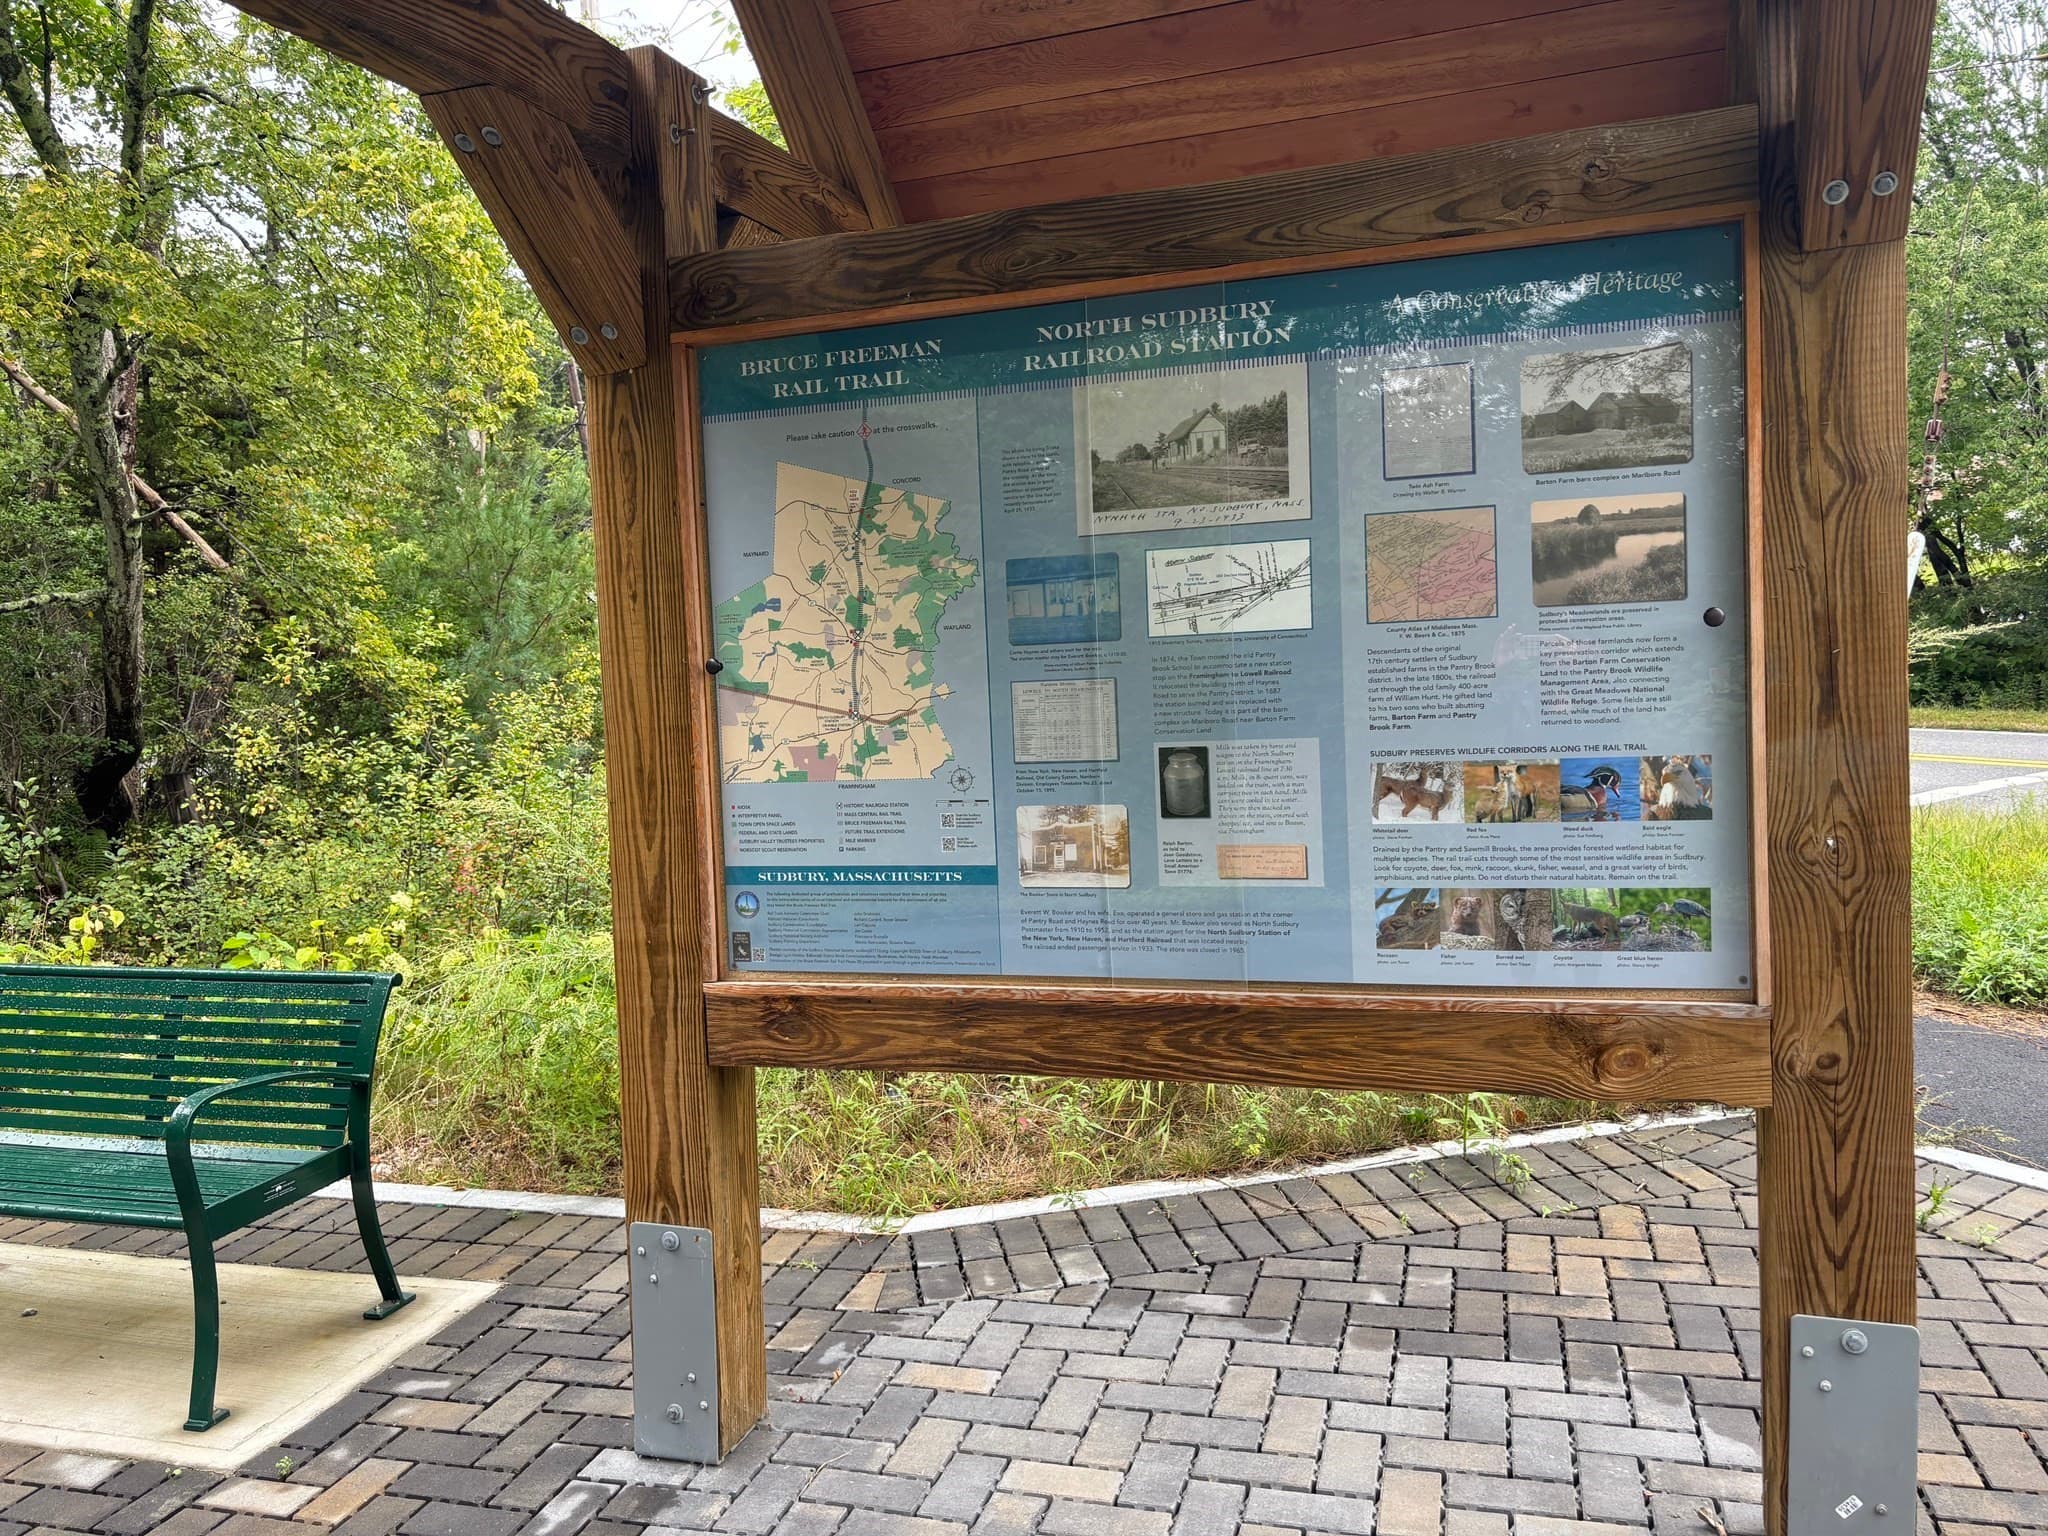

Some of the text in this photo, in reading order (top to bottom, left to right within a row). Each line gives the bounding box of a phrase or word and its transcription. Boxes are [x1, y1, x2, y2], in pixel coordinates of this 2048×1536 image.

[1387, 269, 1684, 318] A Conservation Heritage
[1037, 300, 1276, 342] NORTH SUDBURY
[1024, 327, 1291, 371] RAILROAD STATION
[740, 339, 941, 376] BRUCE FREEMAN
[773, 370, 909, 398] RAIL TRAIL
[785, 432, 808, 442] Please
[828, 427, 855, 438] caution
[872, 425, 880, 434] at
[881, 424, 894, 433] the
[896, 419, 938, 432] crosswalks.
[892, 476, 921, 484] CONCORD
[1535, 477, 1557, 485] Barton
[1557, 476, 1574, 484] Farm
[1592, 472, 1620, 483] complex
[1631, 470, 1661, 478] Marlboro
[1663, 468, 1680, 476] Road
[1368, 652, 1478, 666] 17th century settlers of Sudbury
[1539, 654, 1670, 666] from the Barton Farm Conservation
[1367, 665, 1406, 674] established
[1407, 664, 1427, 672] farms
[1436, 663, 1449, 671] the
[1449, 662, 1473, 672] Pantry
[1474, 661, 1495, 669] Brook
[1539, 668, 1558, 676] Land
[1569, 667, 1582, 675] the
[1583, 666, 1608, 676] Pantry
[1609, 665, 1632, 673] Brook
[1633, 664, 1663, 672] Wildlife
[1540, 677, 1589, 688] Management
[1590, 676, 1611, 685] Area,
[1628, 674, 1669, 684] connecting
[1367, 685, 1380, 693] cut
[1380, 684, 1407, 694] through
[1409, 683, 1421, 691] the
[1435, 682, 1456, 692] family
[1540, 684, 1664, 696] with the Great Meadows National
[1368, 694, 1385, 702] farm
[1394, 693, 1419, 701] William
[1421, 692, 1440, 700] Hunt.
[1453, 691, 1475, 700] gifted
[1476, 690, 1492, 698] land
[1540, 697, 1569, 705] Wildlife
[1570, 696, 1599, 706] Refuge.
[1601, 695, 1623, 703] Some
[1623, 694, 1643, 703] fields
[1658, 693, 1671, 702] still
[1368, 713, 1390, 722] farms,
[1391, 712, 1415, 720] Barton
[1417, 711, 1436, 719] Farm
[1452, 710, 1477, 720] Pantry
[1540, 704, 1666, 717] farmed, while much of the land has
[1369, 722, 1391, 730] Brook
[1541, 715, 1621, 725] returned to woodland.
[1369, 749, 1407, 757] SUDBURY
[1410, 748, 1455, 756] PRESERVES
[1457, 747, 1495, 755] WILDLIFE
[1497, 745, 1547, 754] CORRIDORS
[1549, 744, 1581, 752] ALONG
[1602, 743, 1621, 751] RAIL
[1373, 854, 1401, 864] multiple
[1402, 854, 1431, 863] species.
[1489, 854, 1518, 863] through
[1540, 853, 1549, 861] of
[1549, 853, 1561, 861] the
[1673, 852, 1705, 862] Sudbury.
[757, 871, 962, 882] SUDBURY, MASSACHUSETTS
[1207, 927, 1226, 935] North
[1228, 928, 1255, 937] Sudbury
